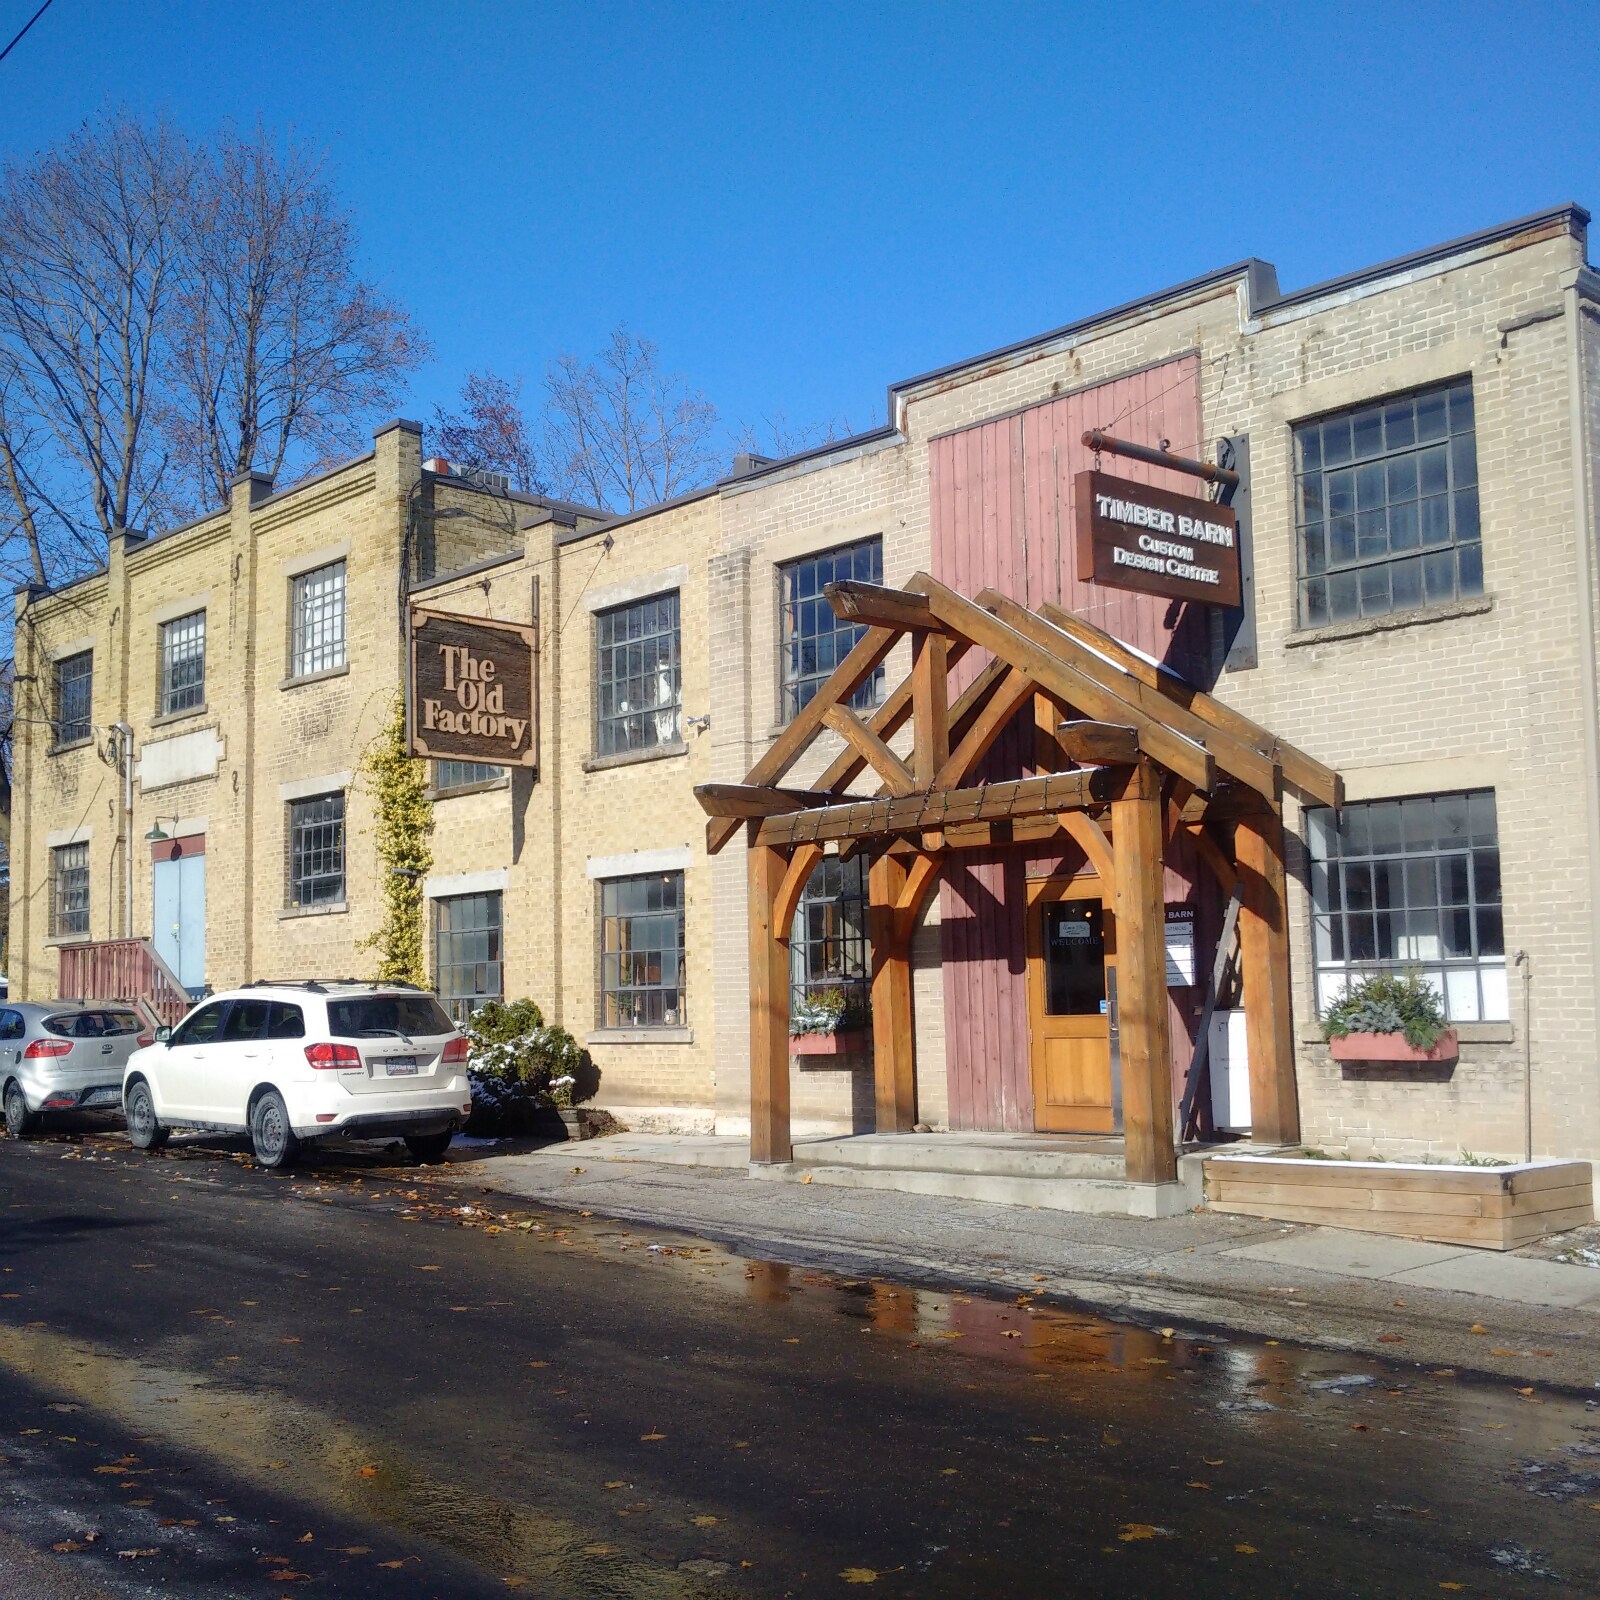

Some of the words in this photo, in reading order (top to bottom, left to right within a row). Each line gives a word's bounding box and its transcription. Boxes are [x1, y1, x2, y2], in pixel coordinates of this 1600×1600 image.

[1096, 493, 1176, 534] TIMBER
[1178, 514, 1234, 547] BARN
[1113, 546, 1165, 574] DESIGN
[1166, 559, 1219, 585] CENTRE
[1138, 534, 1194, 562] CUSTOM
[438, 644, 496, 691] The
[457, 680, 506, 714] Old
[423, 698, 528, 750] Factory
[1168, 910, 1194, 919] BARN
[1050, 937, 1099, 946] WELCOME
